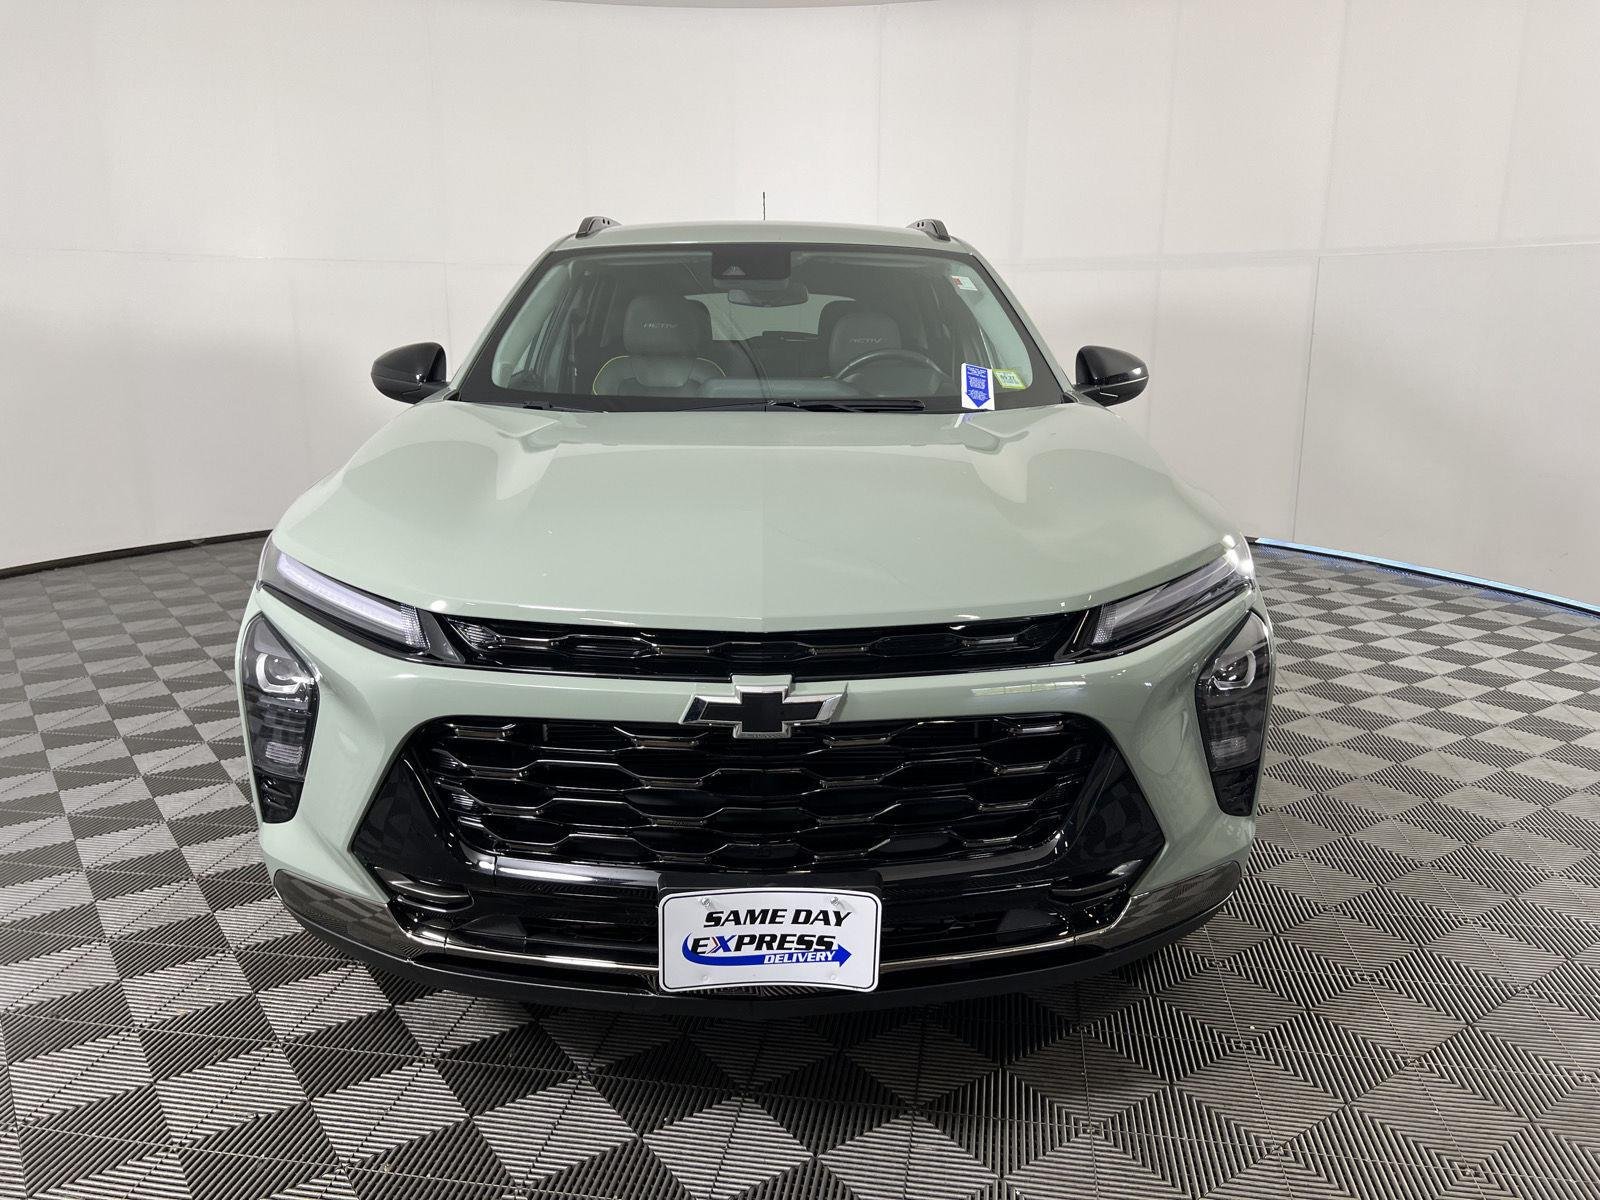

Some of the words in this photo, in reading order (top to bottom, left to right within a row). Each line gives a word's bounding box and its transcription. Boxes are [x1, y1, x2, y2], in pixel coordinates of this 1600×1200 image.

[703, 908, 788, 928] SAME
[791, 908, 852, 927] DAY
[690, 933, 836, 955] EXPRESS
[763, 950, 837, 965] DELIVERY
